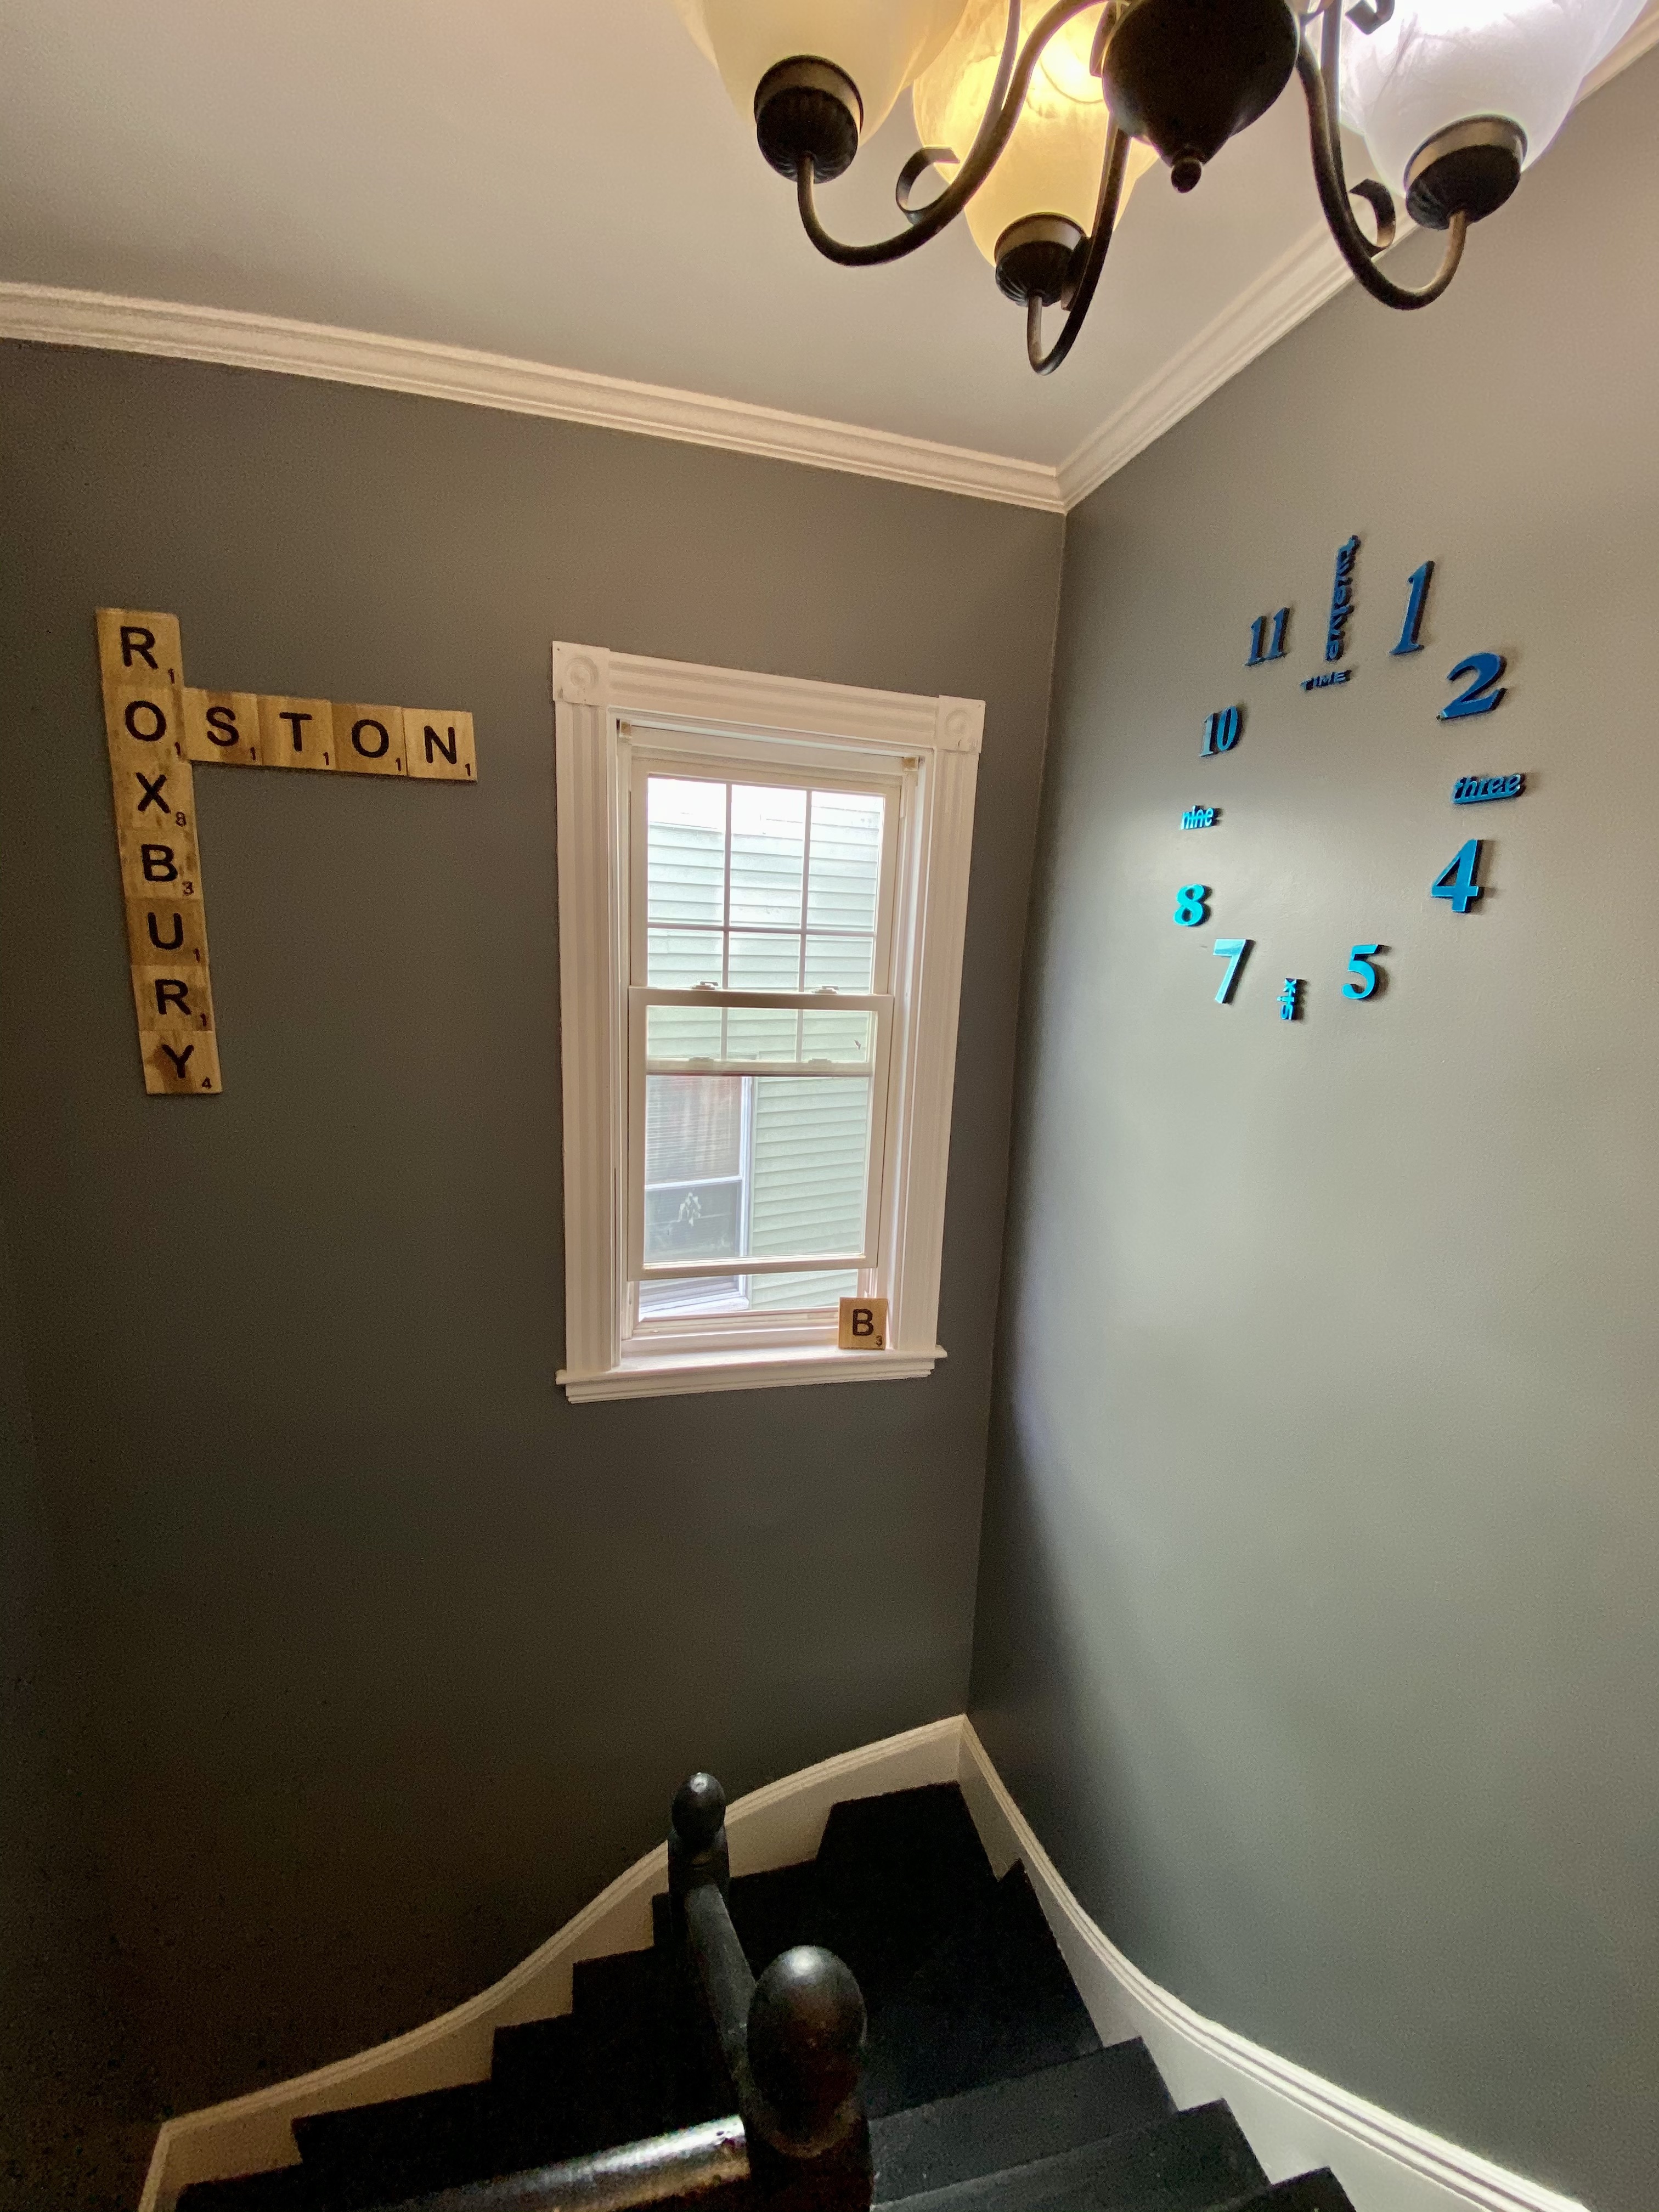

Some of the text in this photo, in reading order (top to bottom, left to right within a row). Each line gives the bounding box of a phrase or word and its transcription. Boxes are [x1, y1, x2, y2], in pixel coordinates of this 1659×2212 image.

[1390, 561, 1432, 656] 1
[1244, 607, 1289, 667] 11
[1300, 669, 1352, 691] TIME
[1438, 652, 1505, 720] 2
[1200, 705, 1242, 758] 10
[1451, 774, 1523, 804] three
[174, 811, 188, 828] 8
[1180, 804, 1215, 830] nine
[181, 880, 195, 897] 3
[1431, 838, 1481, 913] 4
[1173, 883, 1206, 927] 8
[1213, 938, 1250, 1004] 7
[1341, 943, 1381, 1000] 5
[1277, 978, 1297, 1020] six
[201, 1076, 213, 1090] 4
[852, 1308, 874, 1336] B
[875, 1334, 883, 1346] 3
